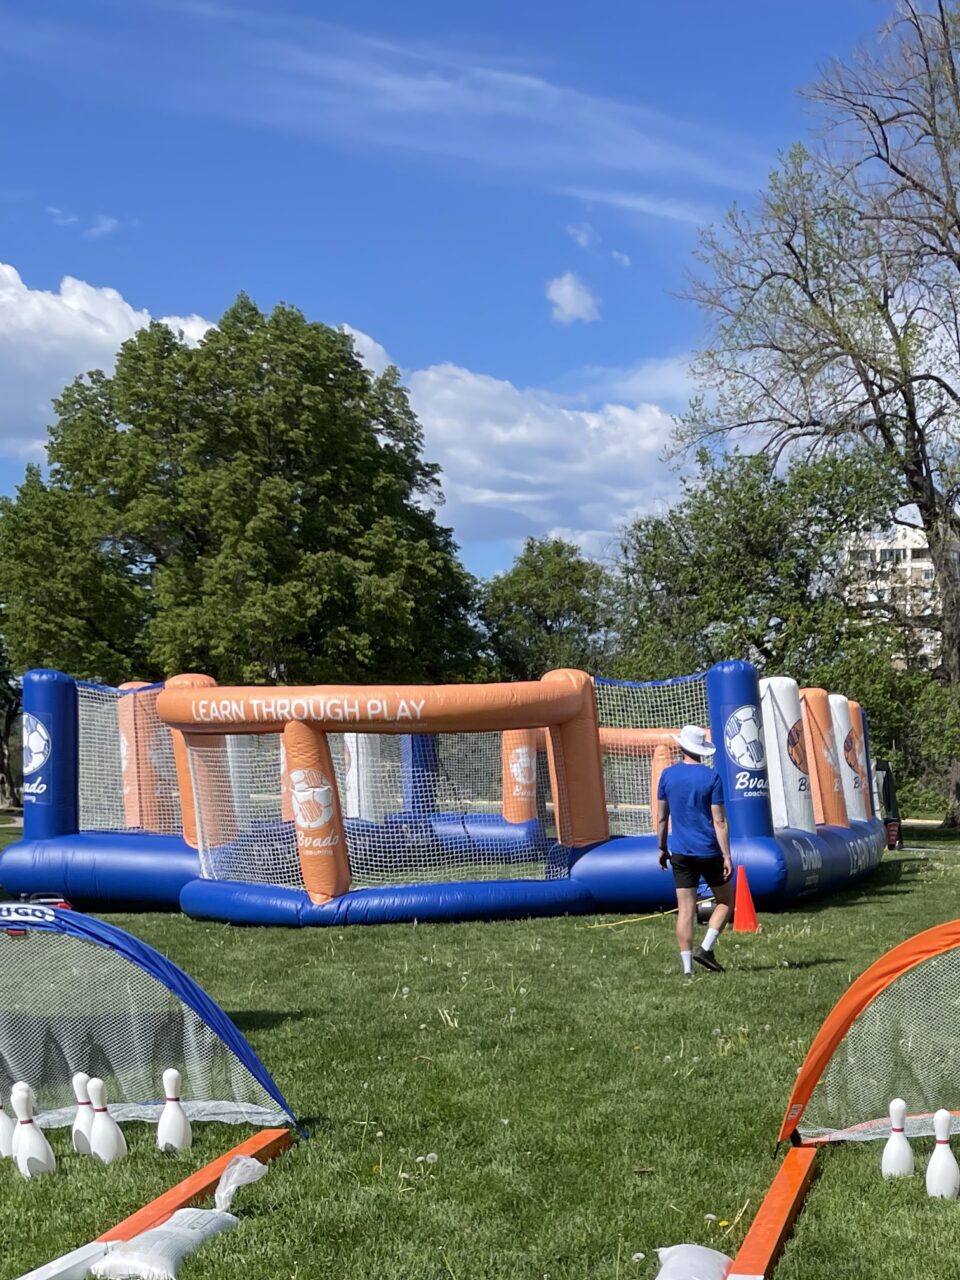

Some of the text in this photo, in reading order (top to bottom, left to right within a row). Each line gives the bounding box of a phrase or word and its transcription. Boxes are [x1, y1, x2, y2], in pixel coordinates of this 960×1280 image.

[192, 699, 425, 721] LEARN THROUGH PLAY
[735, 771, 769, 789] Bva
[296, 829, 339, 847] Bvado
[0, 906, 46, 920] UGG
